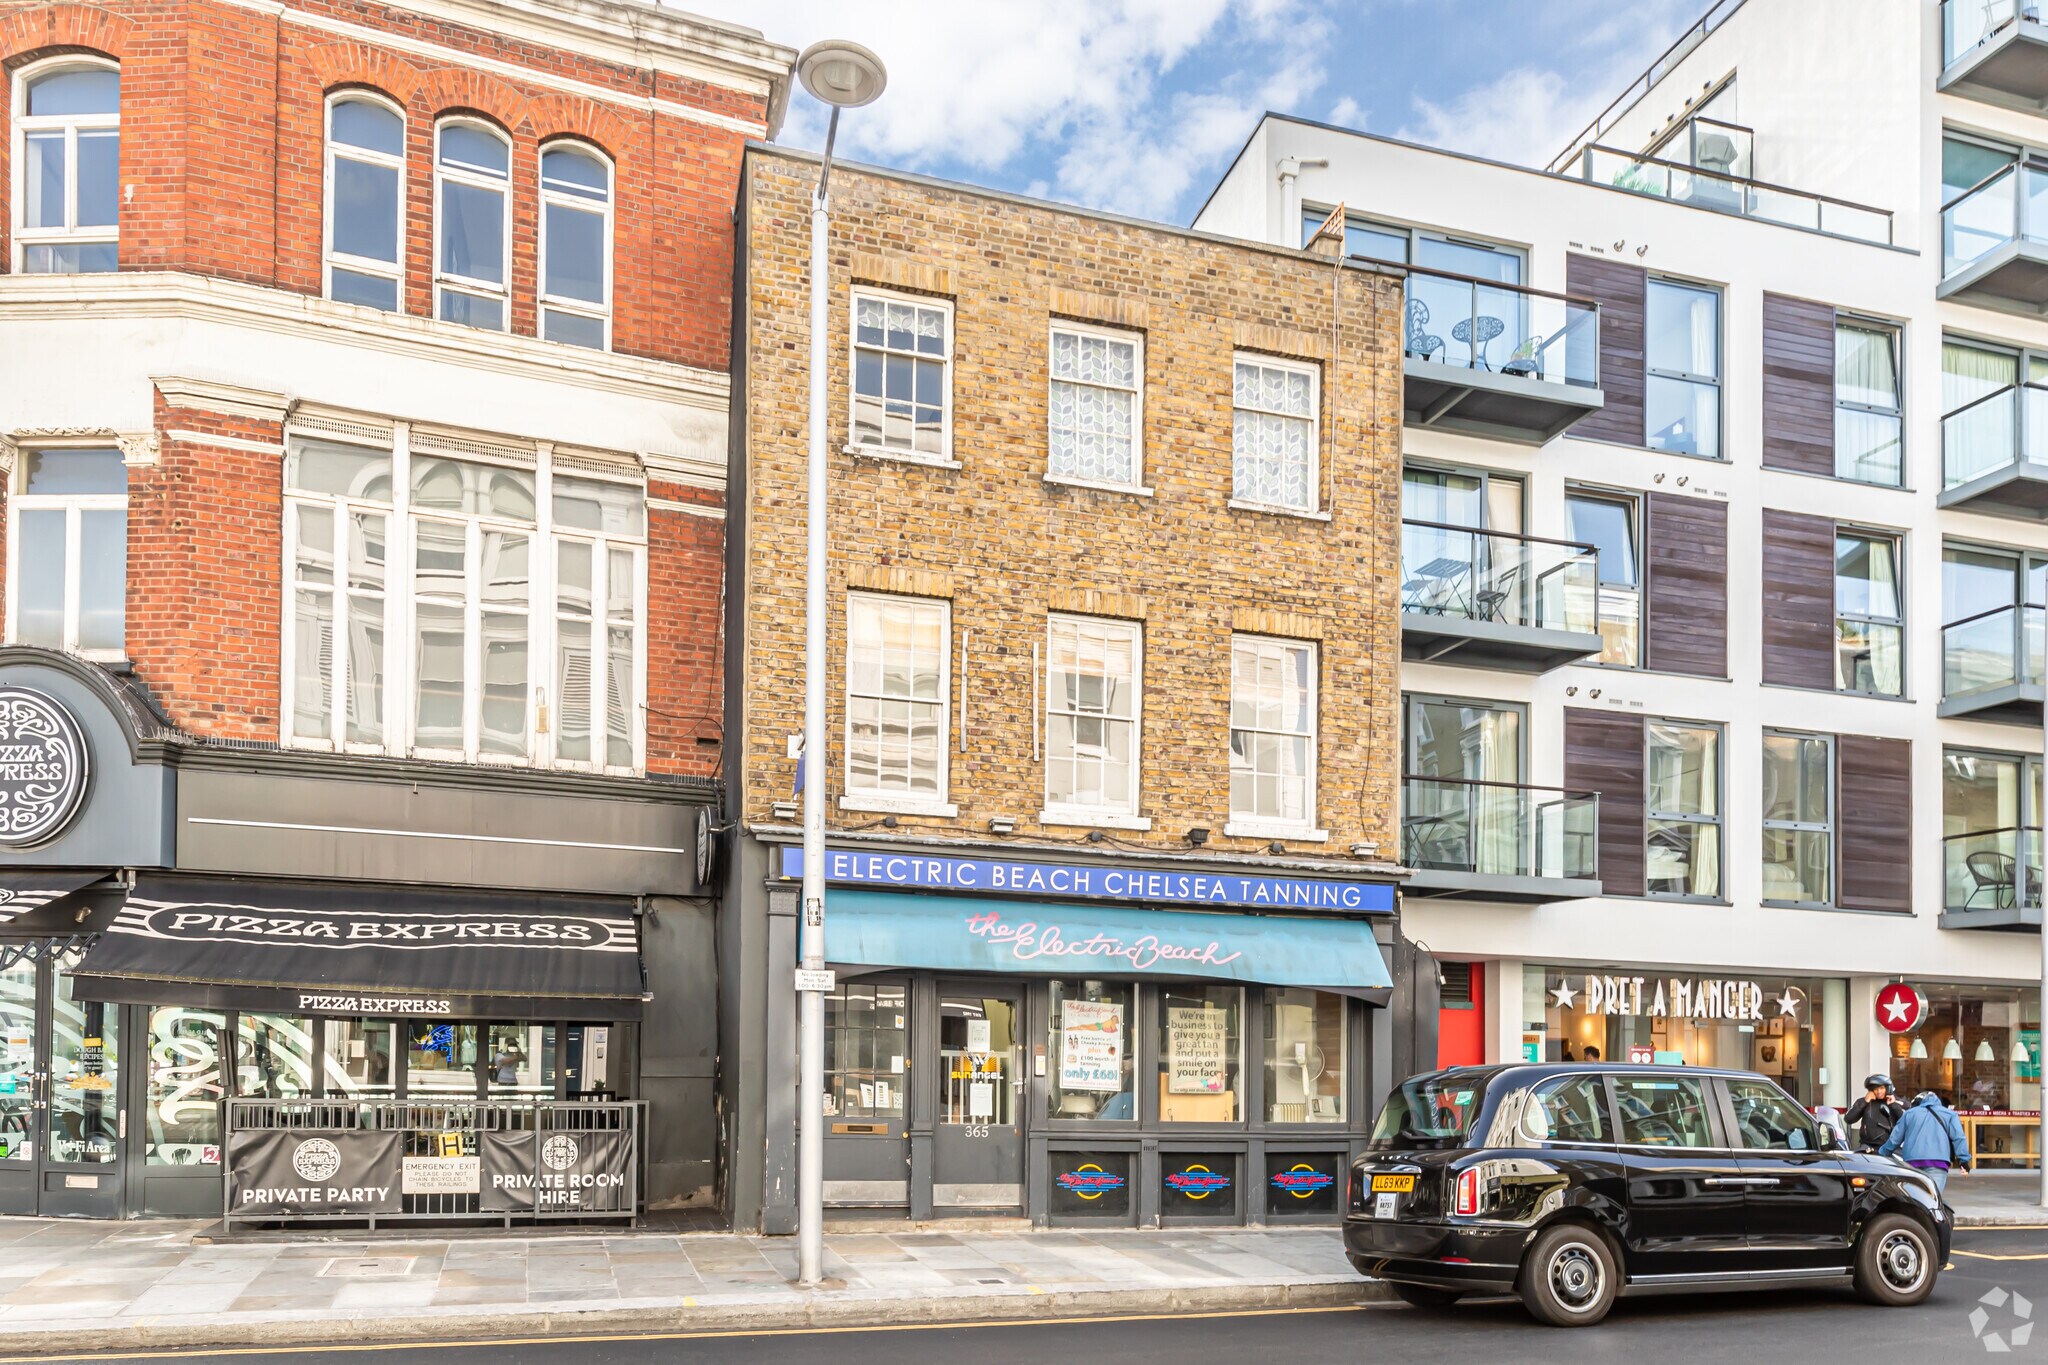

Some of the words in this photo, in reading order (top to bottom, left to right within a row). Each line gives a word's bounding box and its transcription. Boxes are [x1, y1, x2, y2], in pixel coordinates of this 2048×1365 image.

[834, 855, 977, 886] ELECTRIC
[992, 865, 1089, 892] BEACH
[1104, 872, 1227, 900] CHELSEA
[1240, 880, 1361, 907] TANNING
[168, 912, 342, 939] PIZZA
[345, 921, 594, 940] EXPRESS
[1589, 974, 1645, 1016] PRET
[1652, 978, 1667, 1017] A
[1675, 979, 1764, 1020] MANGER
[299, 995, 359, 1011] PIZZA
[360, 997, 451, 1014] EXPRESS
[1179, 1011, 1205, 1021] We're
[1171, 1020, 1212, 1029] business
[1174, 1031, 1194, 1040] give
[1195, 1032, 1213, 1040] you
[1176, 1041, 1200, 1050] great
[1203, 1041, 1218, 1049] tan
[1175, 1049, 1193, 1057] and
[1195, 1050, 1211, 1060] put
[1178, 1059, 1203, 1067] smile
[1064, 1067, 1090, 1081] only
[1176, 1069, 1199, 1078] your
[965, 1125, 989, 1138] 365
[87, 1140, 110, 1153] Area
[442, 1136, 460, 1156] H
[569, 1173, 624, 1188] ROOM
[1375, 1177, 1394, 1189] LL69
[1394, 1177, 1411, 1188] KKP
[242, 1187, 322, 1204] PRIVATE
[327, 1187, 389, 1203] PARTY
[540, 1190, 580, 1204] HIRE
